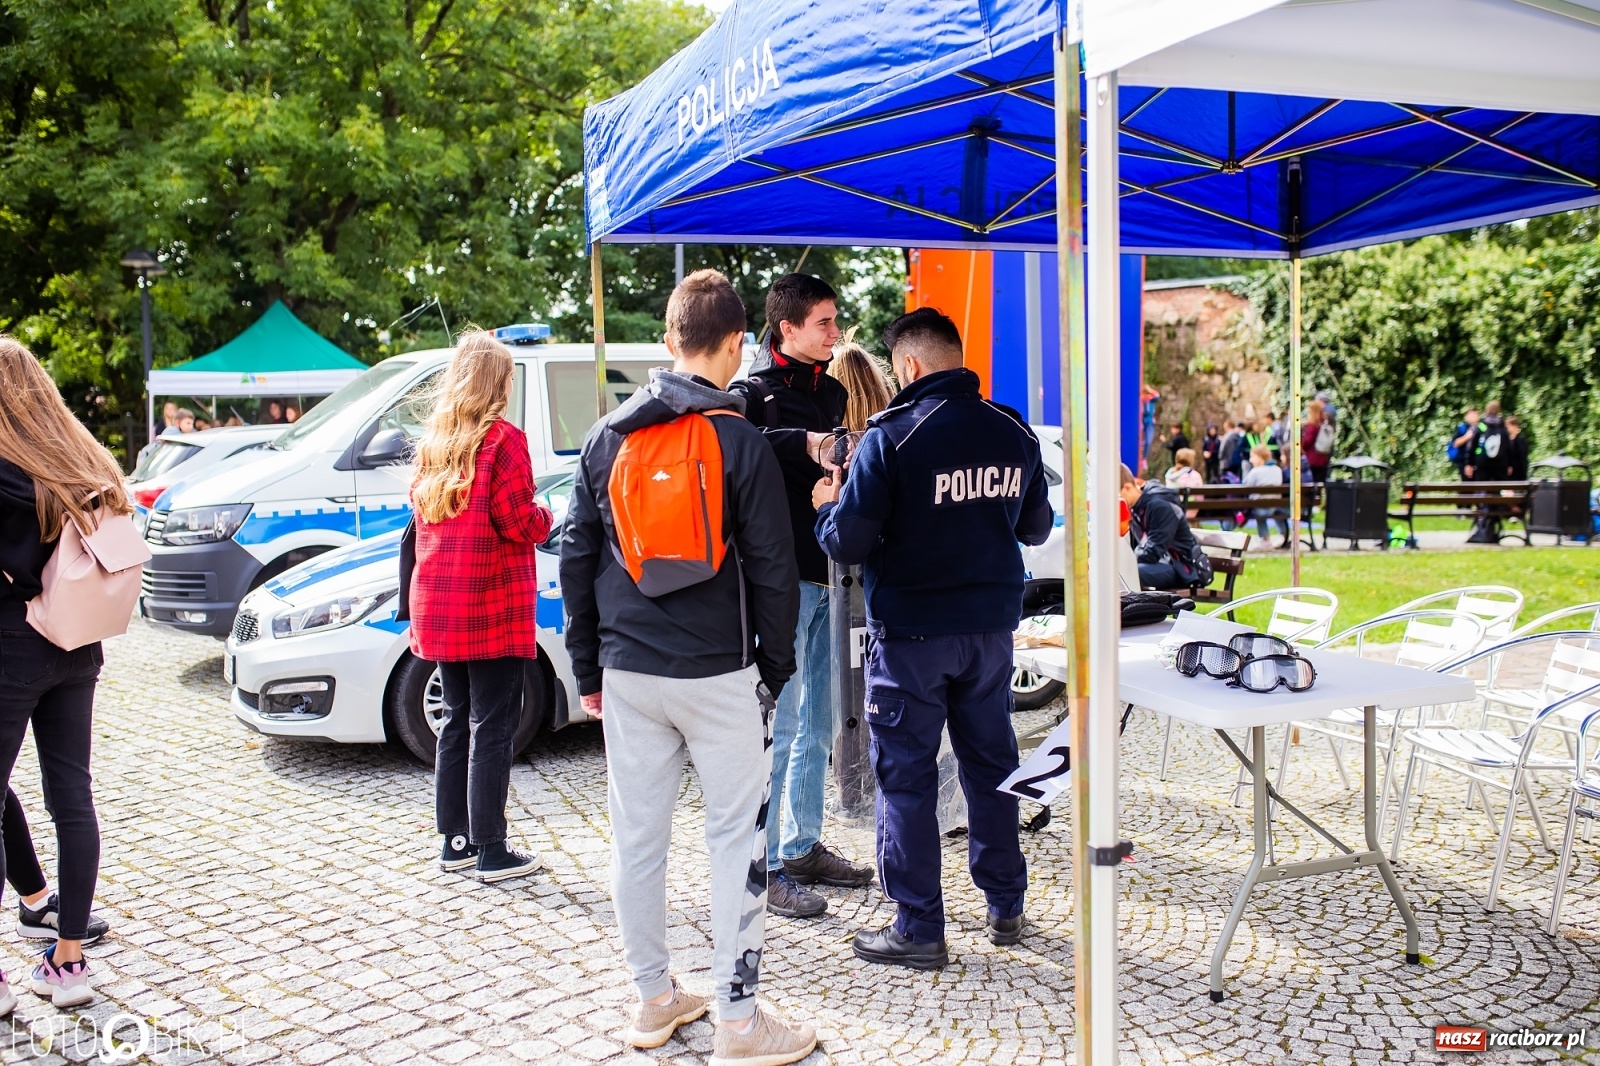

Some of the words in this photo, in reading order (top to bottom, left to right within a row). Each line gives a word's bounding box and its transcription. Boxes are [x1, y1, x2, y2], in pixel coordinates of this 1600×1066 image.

[678, 38, 780, 145] POLICJA
[934, 466, 1022, 505] POLICJA
[1009, 746, 1071, 800] 2
